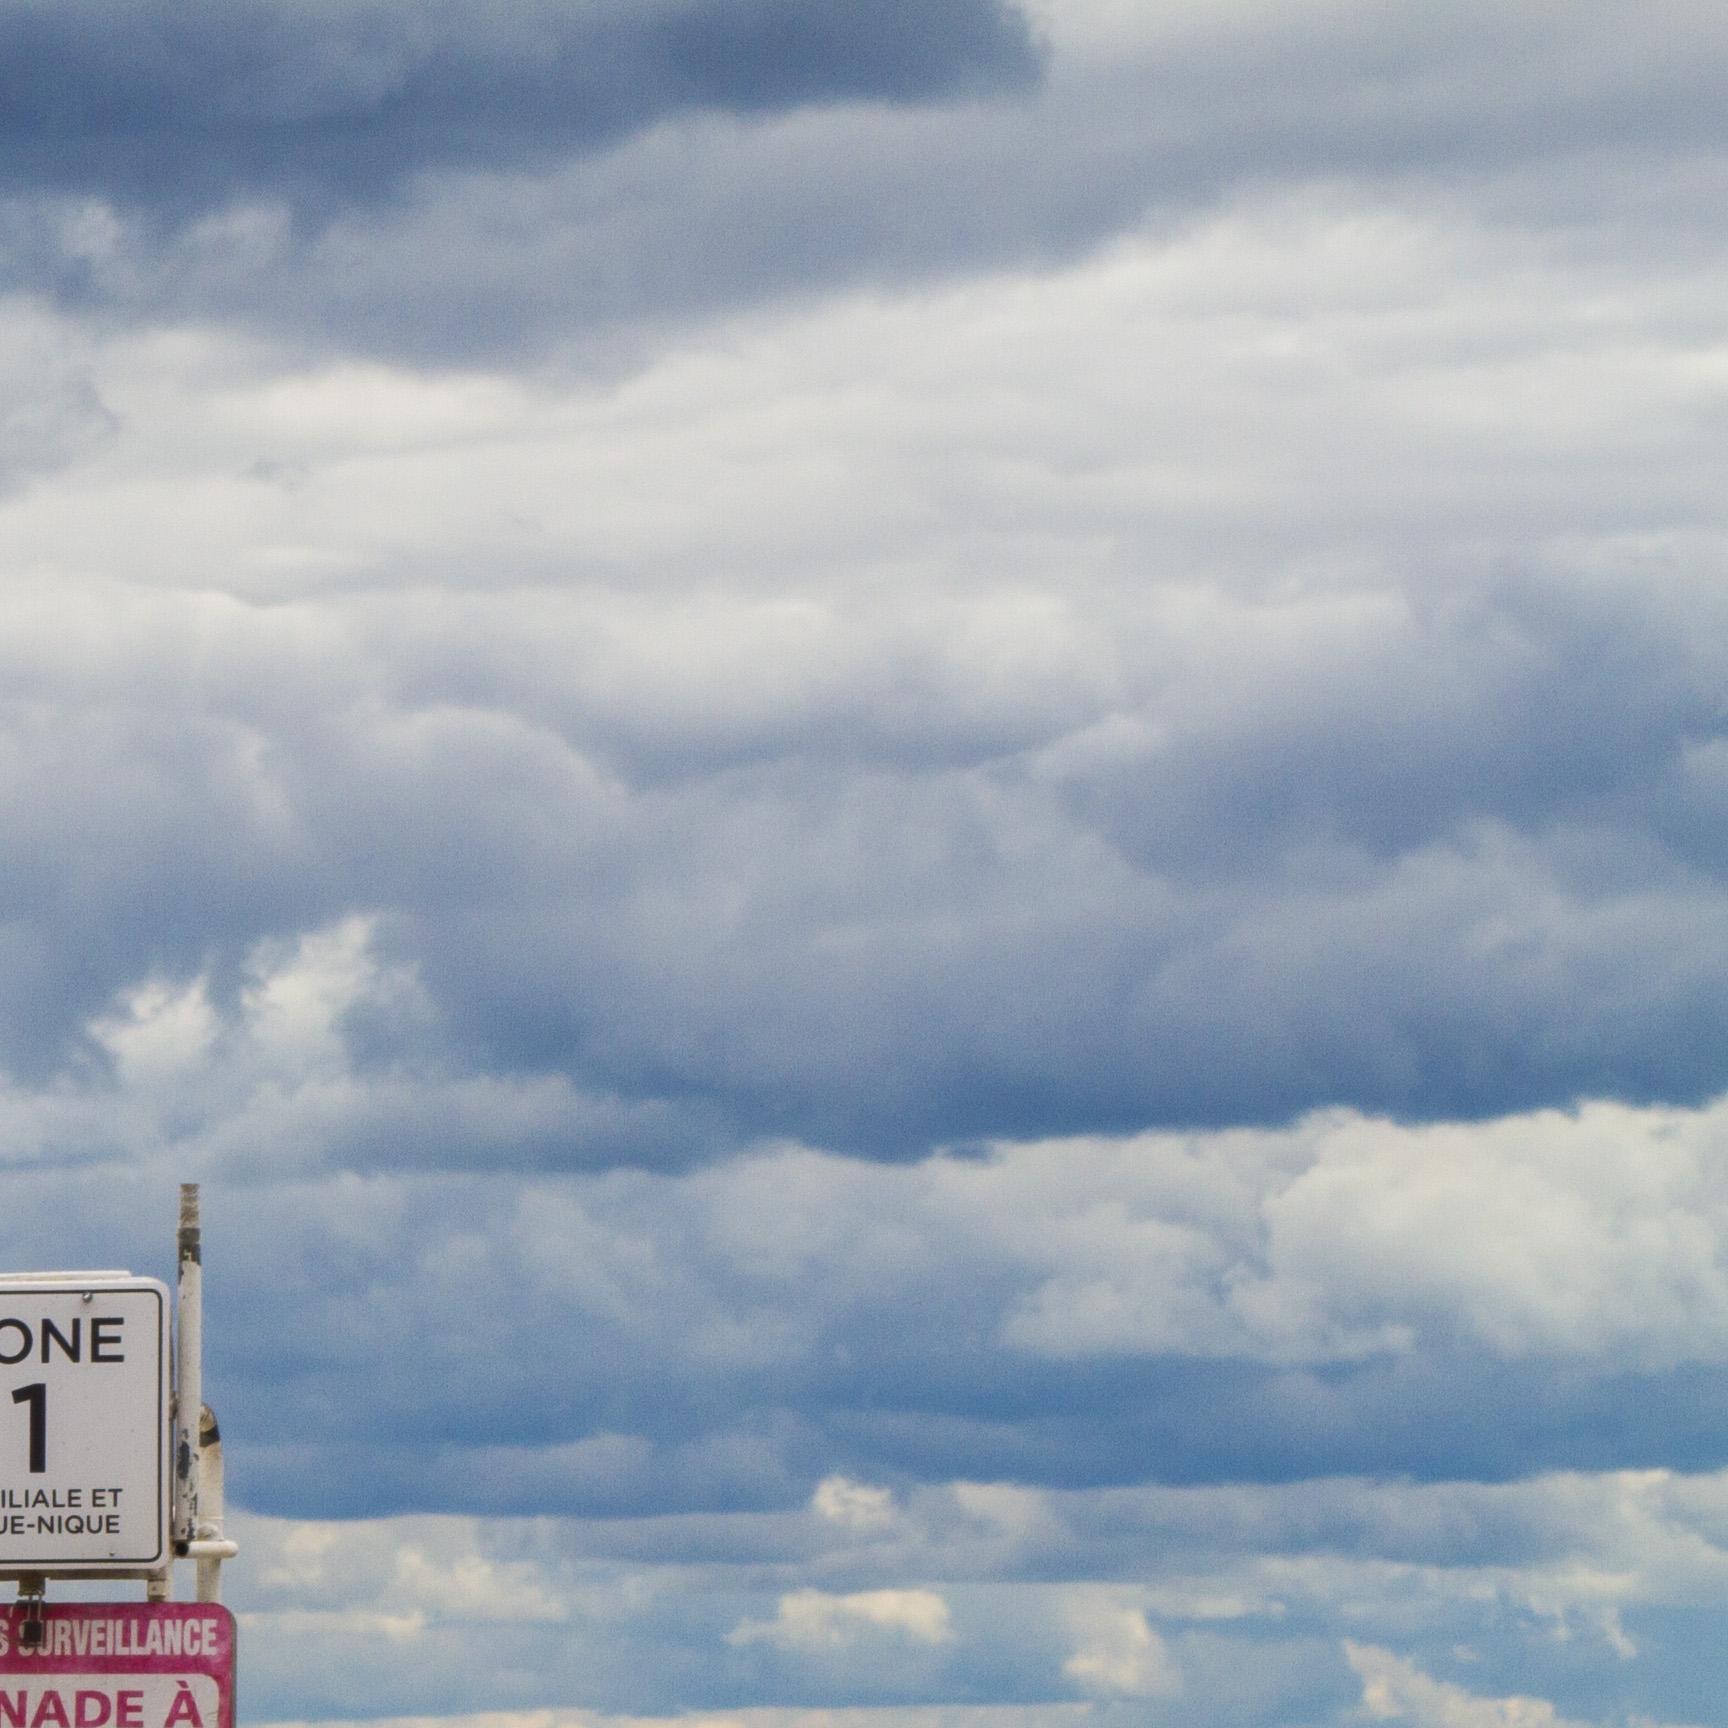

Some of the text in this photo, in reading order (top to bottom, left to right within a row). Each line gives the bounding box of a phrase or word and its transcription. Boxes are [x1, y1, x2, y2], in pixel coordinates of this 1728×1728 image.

[11, 1383, 46, 1473] 1
[91, 1489, 123, 1508] ET
[163, 1680, 204, 1728] À
